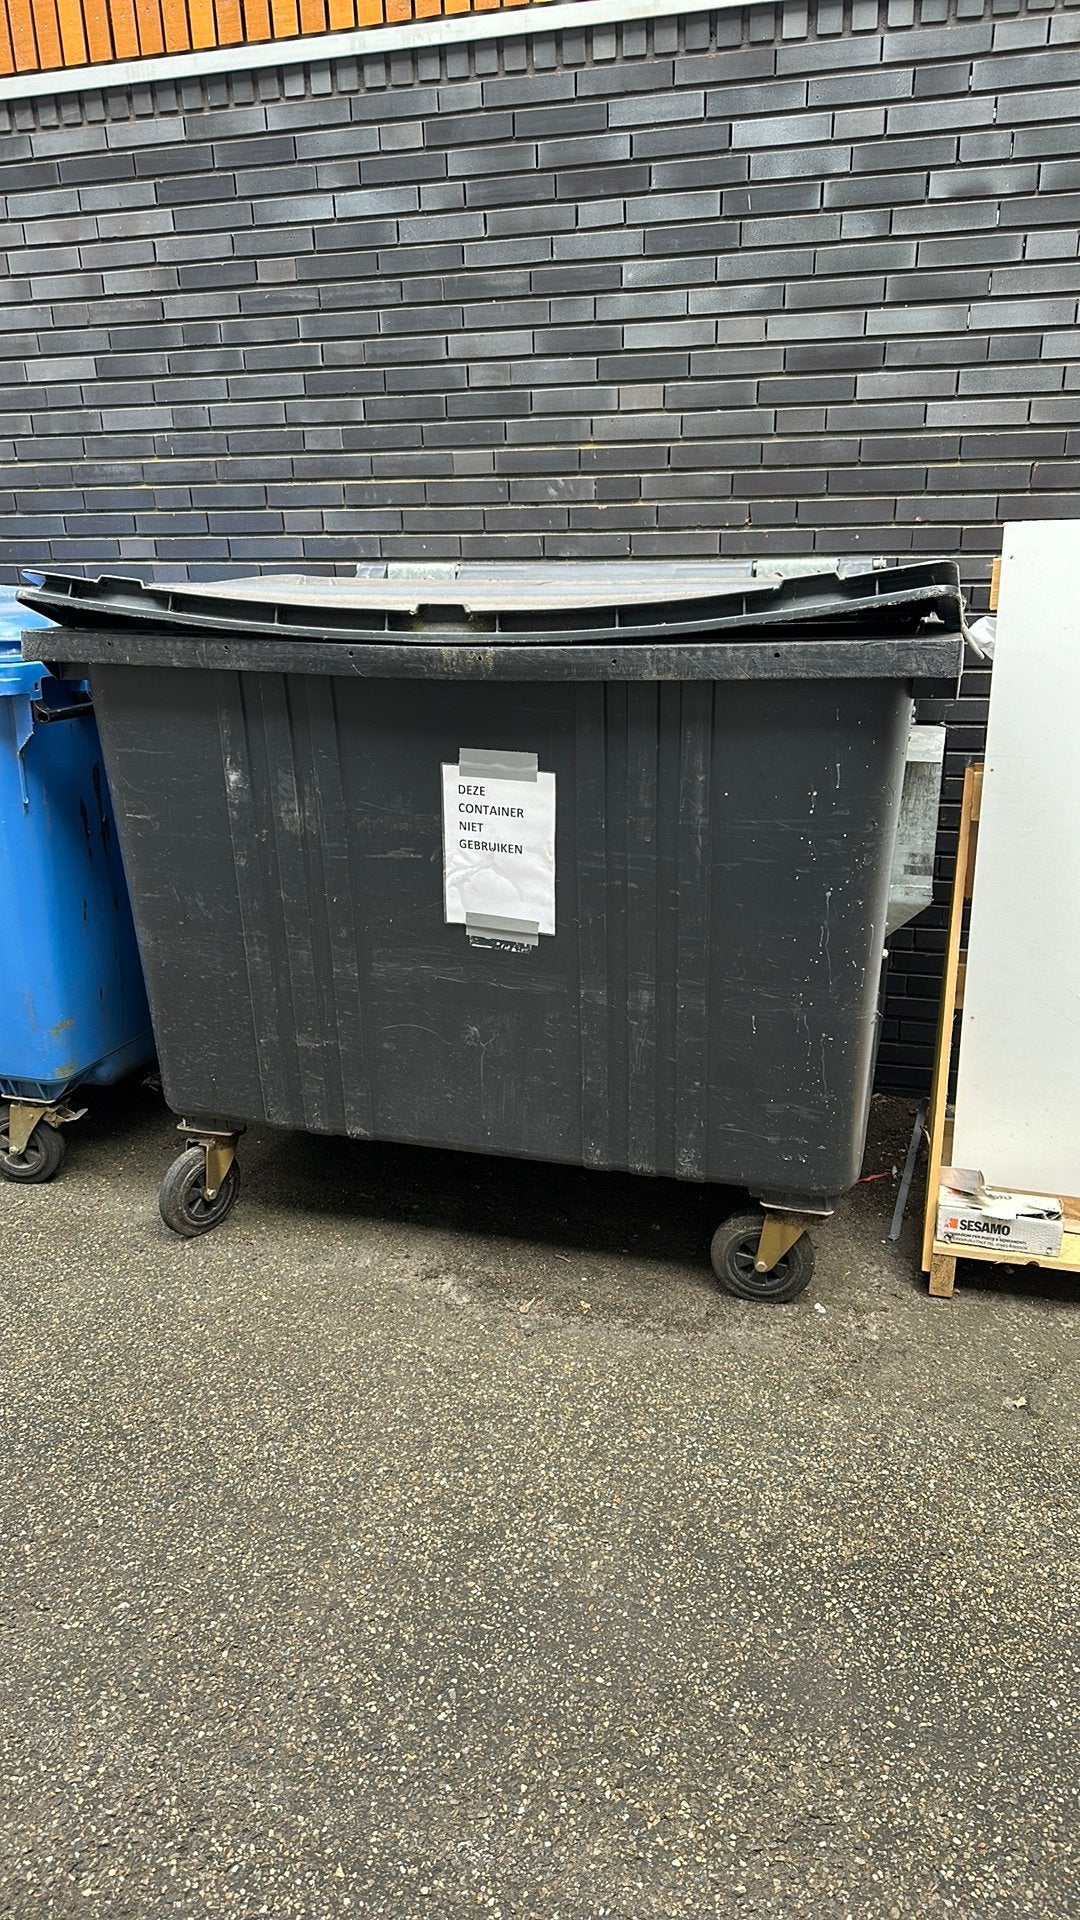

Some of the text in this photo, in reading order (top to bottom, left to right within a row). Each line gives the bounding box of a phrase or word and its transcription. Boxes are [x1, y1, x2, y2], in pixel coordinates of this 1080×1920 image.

[458, 784, 486, 797] DEZE
[458, 802, 524, 819] CONTAINER
[459, 821, 484, 833] NIET
[459, 839, 523, 855] GEBRUIKEN
[959, 1219, 1011, 1236] SESAMO
